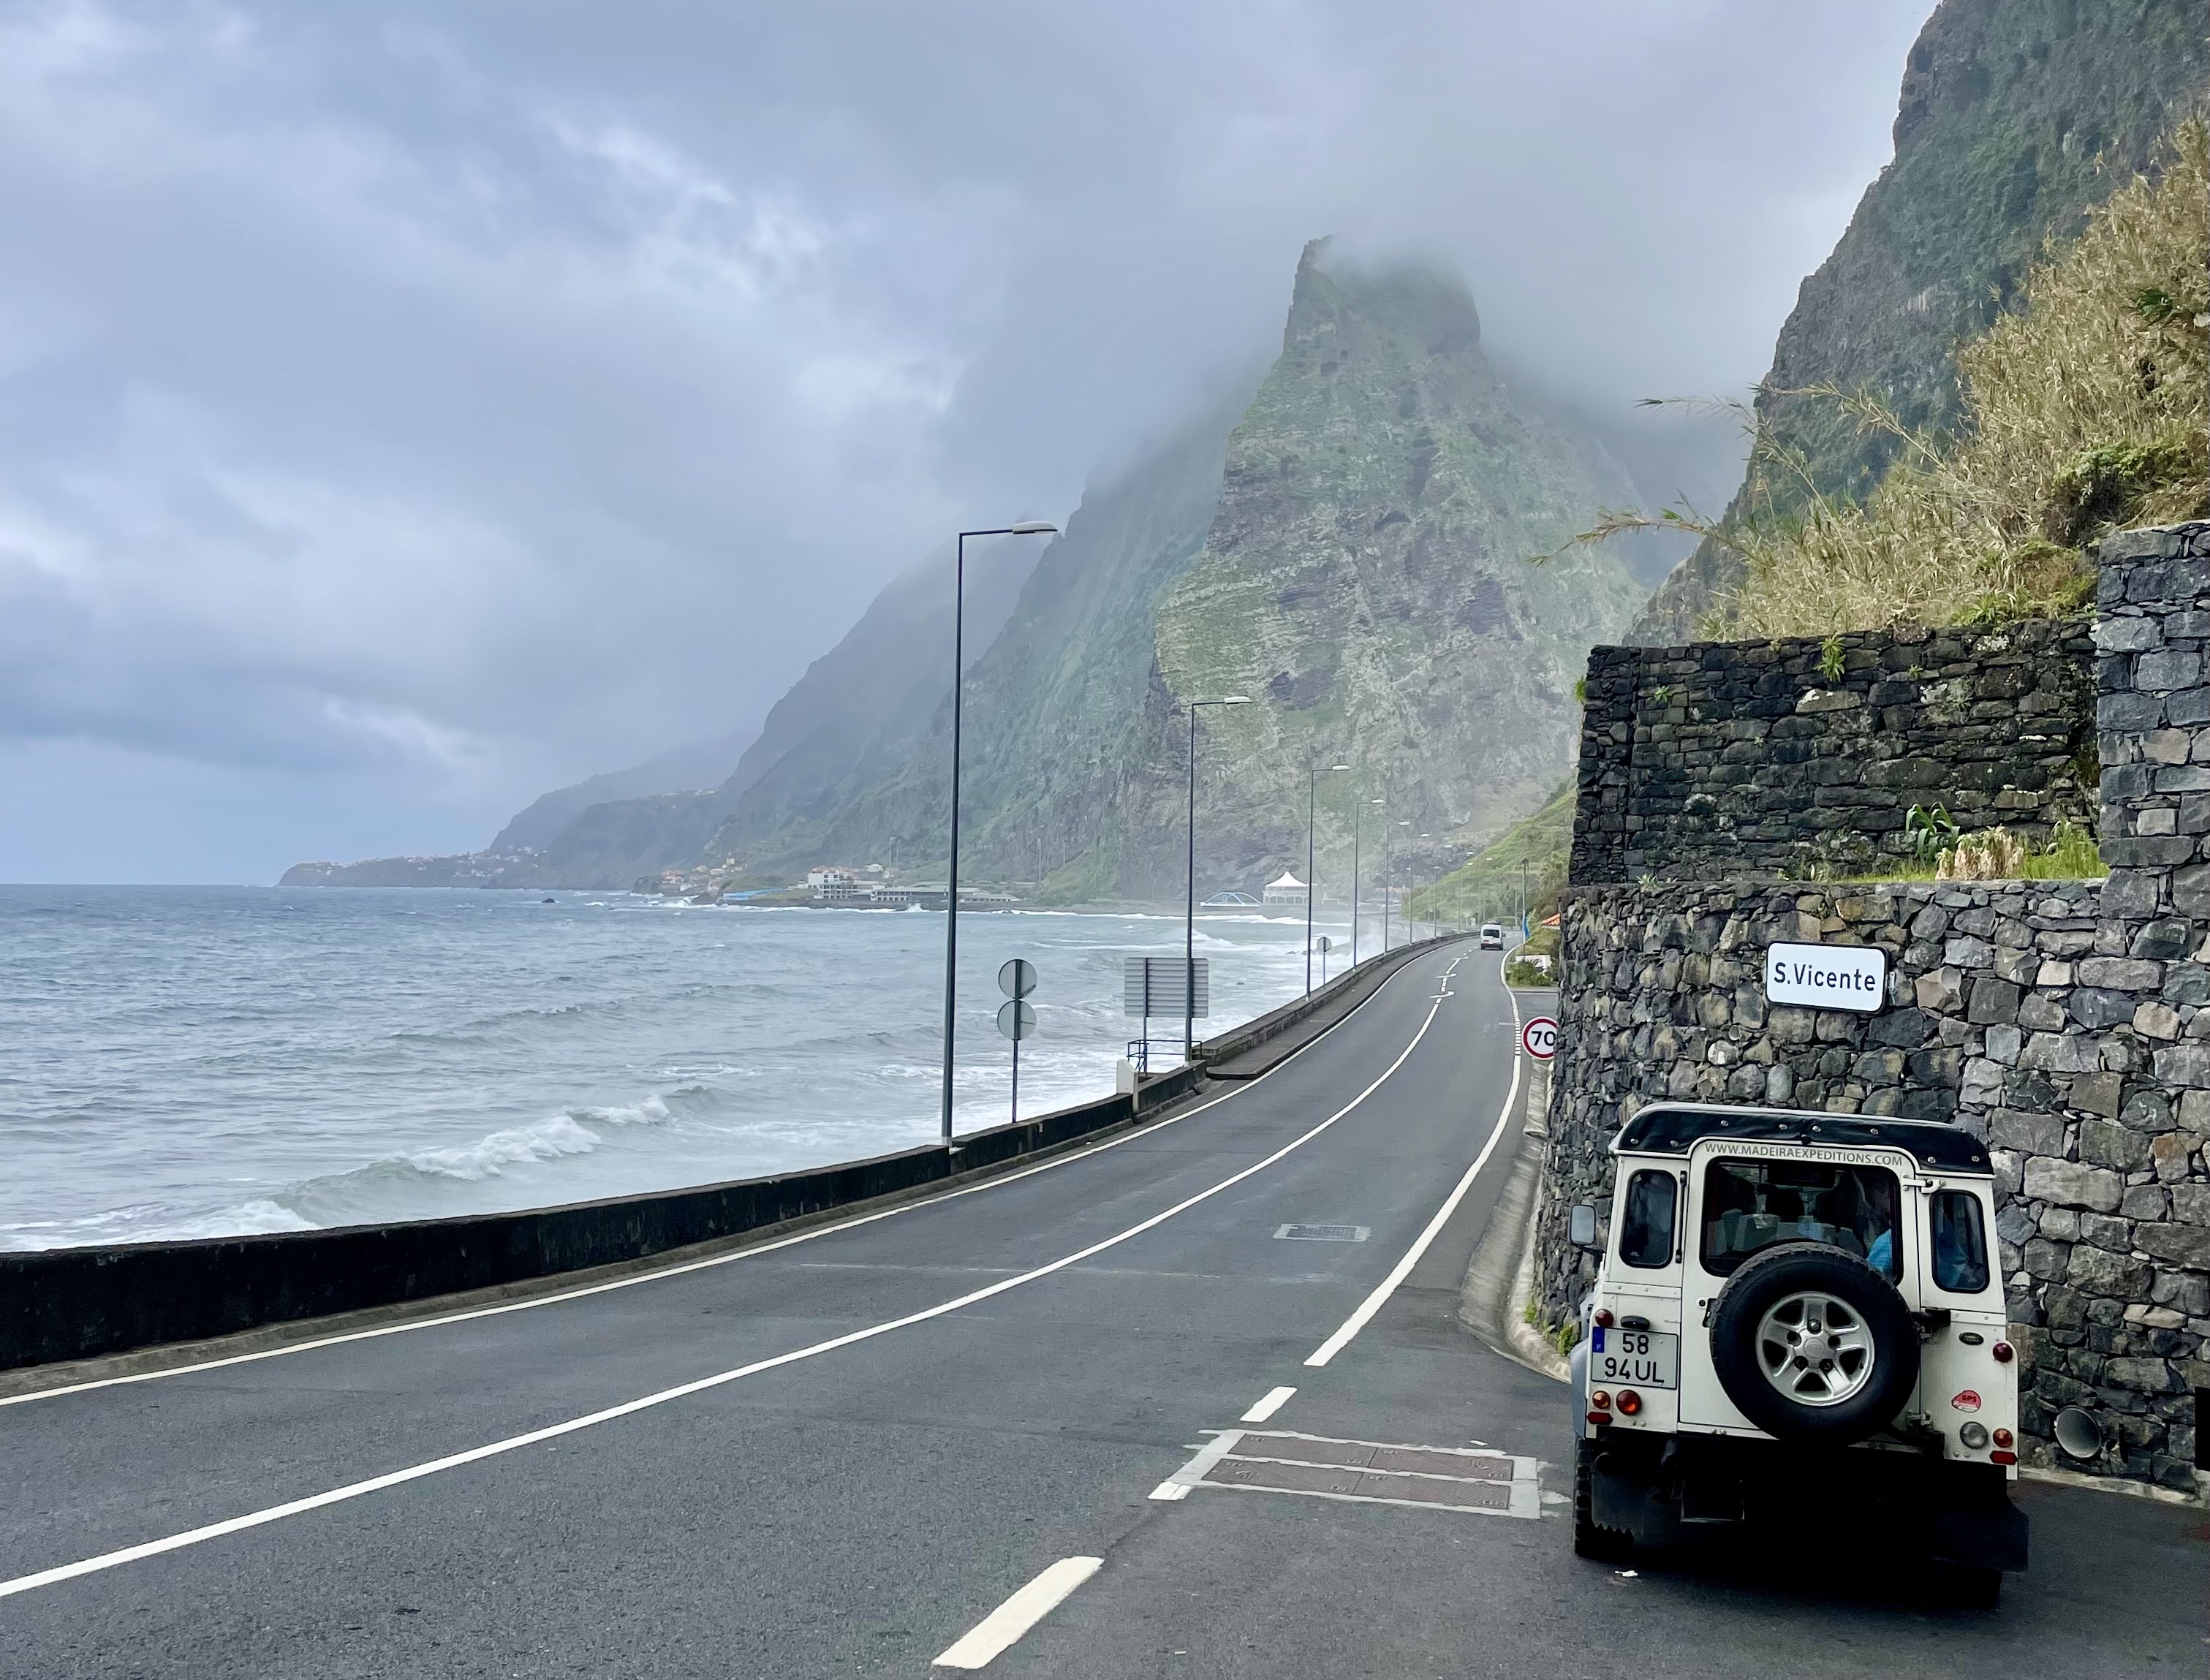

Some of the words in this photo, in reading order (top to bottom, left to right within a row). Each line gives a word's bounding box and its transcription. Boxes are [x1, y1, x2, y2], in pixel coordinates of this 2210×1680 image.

[1774, 961, 1876, 991] S.Vicente
[1531, 1031, 1556, 1046] 70
[1705, 1143, 1902, 1166] WWW.MADEIRAEXPEDITIONS.COM
[1622, 1333, 1649, 1355] 58
[1961, 1394, 1977, 1403] GPS
